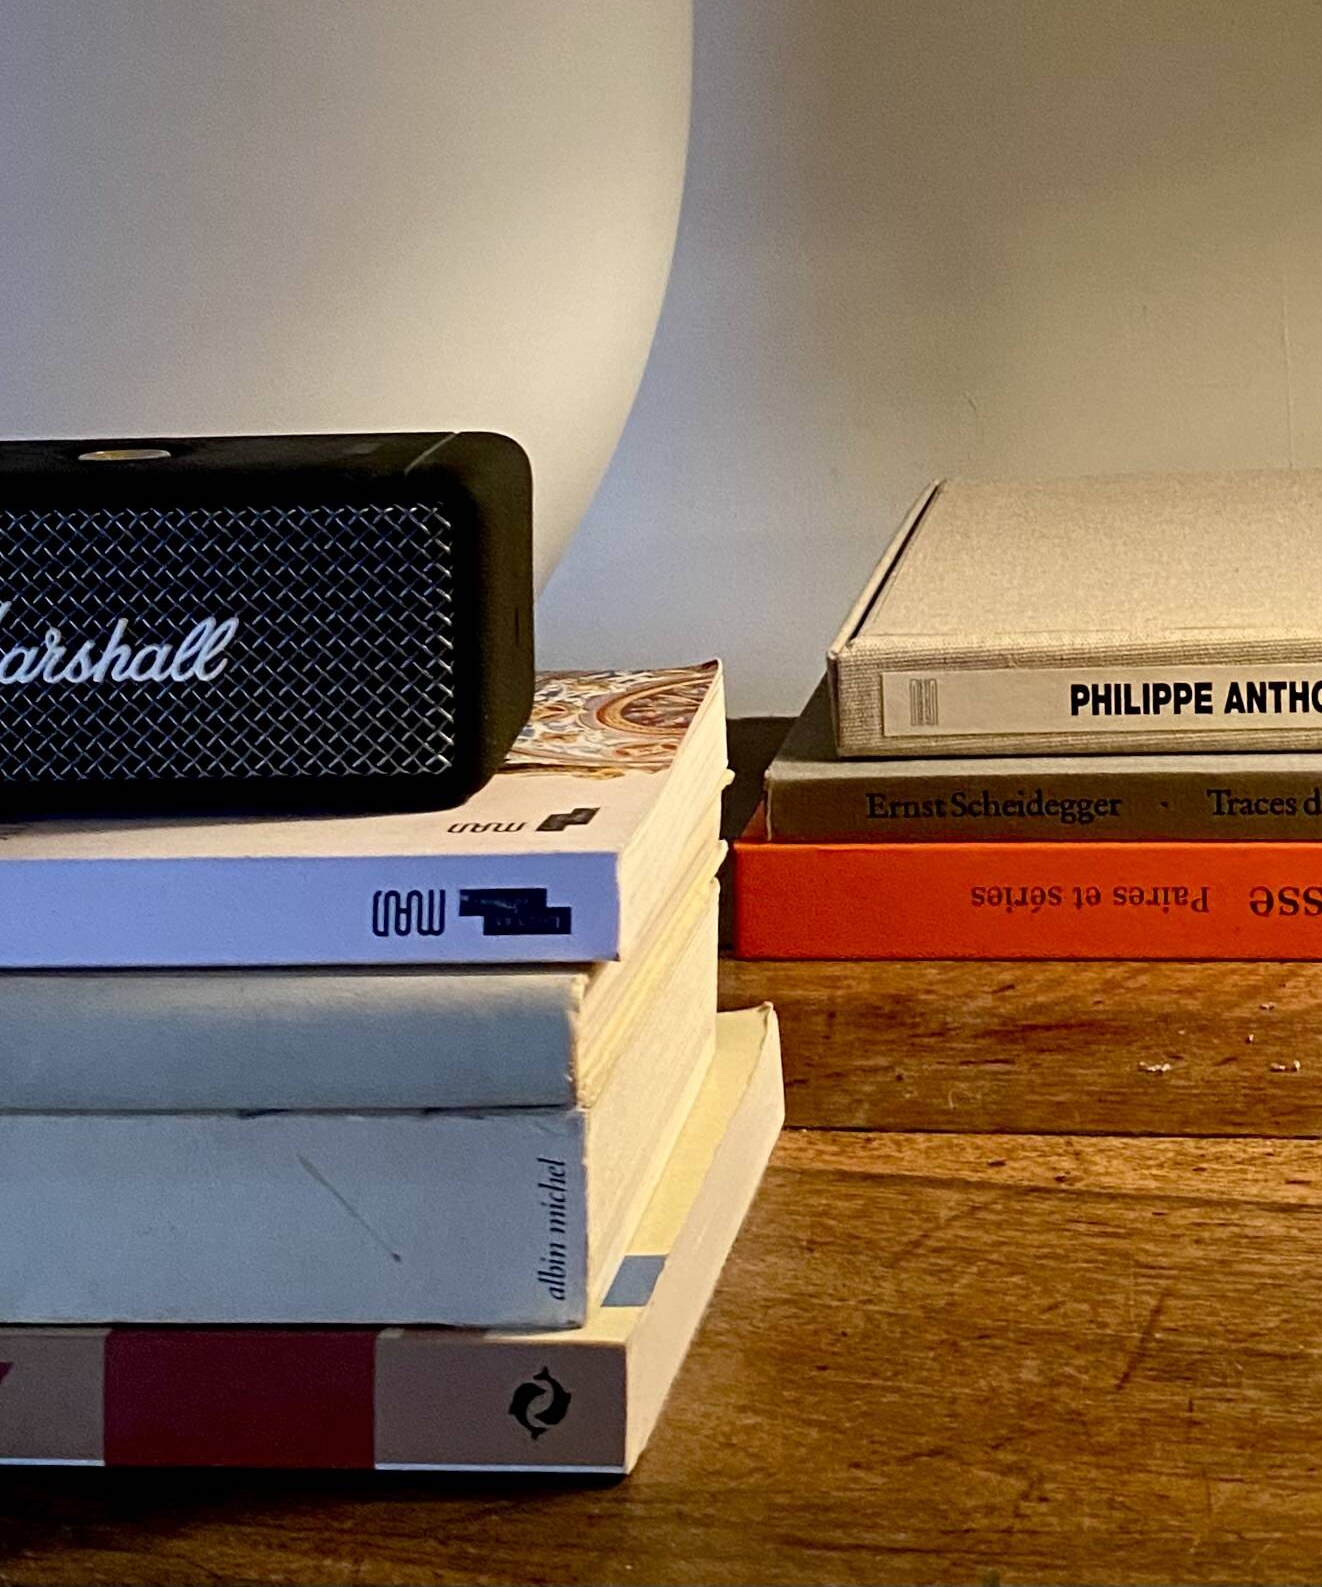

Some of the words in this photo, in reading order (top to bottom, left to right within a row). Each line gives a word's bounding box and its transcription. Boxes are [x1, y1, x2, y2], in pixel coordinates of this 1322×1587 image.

[0, 600, 239, 685] arshall
[1070, 682, 1214, 716] PHILIPPE
[864, 792, 947, 820] Ernst
[949, 787, 1123, 825] Scheidegger
[1205, 787, 1298, 816] Traces
[970, 885, 1063, 914] séries
[1071, 886, 1102, 910] et
[1112, 886, 1211, 915] Paires
[536, 1156, 568, 1234] michel
[537, 1242, 567, 1301] albin
